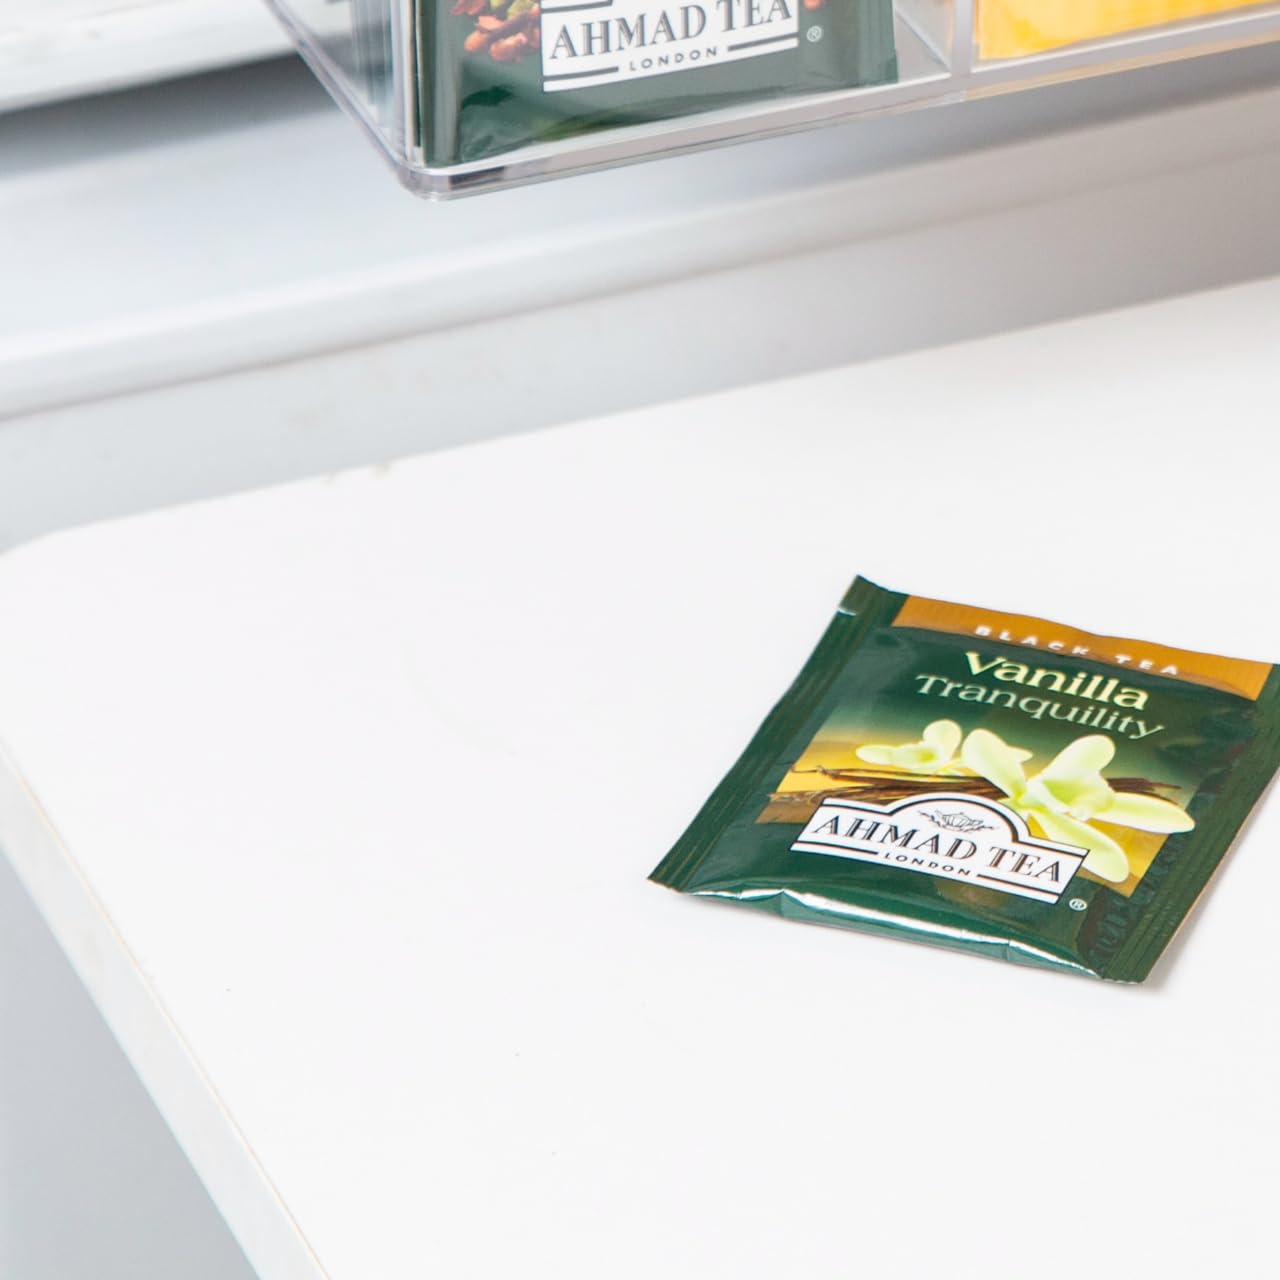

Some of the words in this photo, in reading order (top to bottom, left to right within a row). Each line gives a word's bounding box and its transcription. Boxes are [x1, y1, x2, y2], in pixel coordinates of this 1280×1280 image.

[549, 3, 707, 60] AHMAD
[629, 46, 718, 72] LONDON
[974, 624, 1090, 656] BLACK
[1114, 654, 1179, 676] TEA
[915, 673, 1166, 740] Tranquility
[964, 650, 1150, 711] Vanilla
[812, 814, 978, 861] AHMAD
[986, 845, 1061, 883] TEA
[883, 851, 972, 876] LONDON
